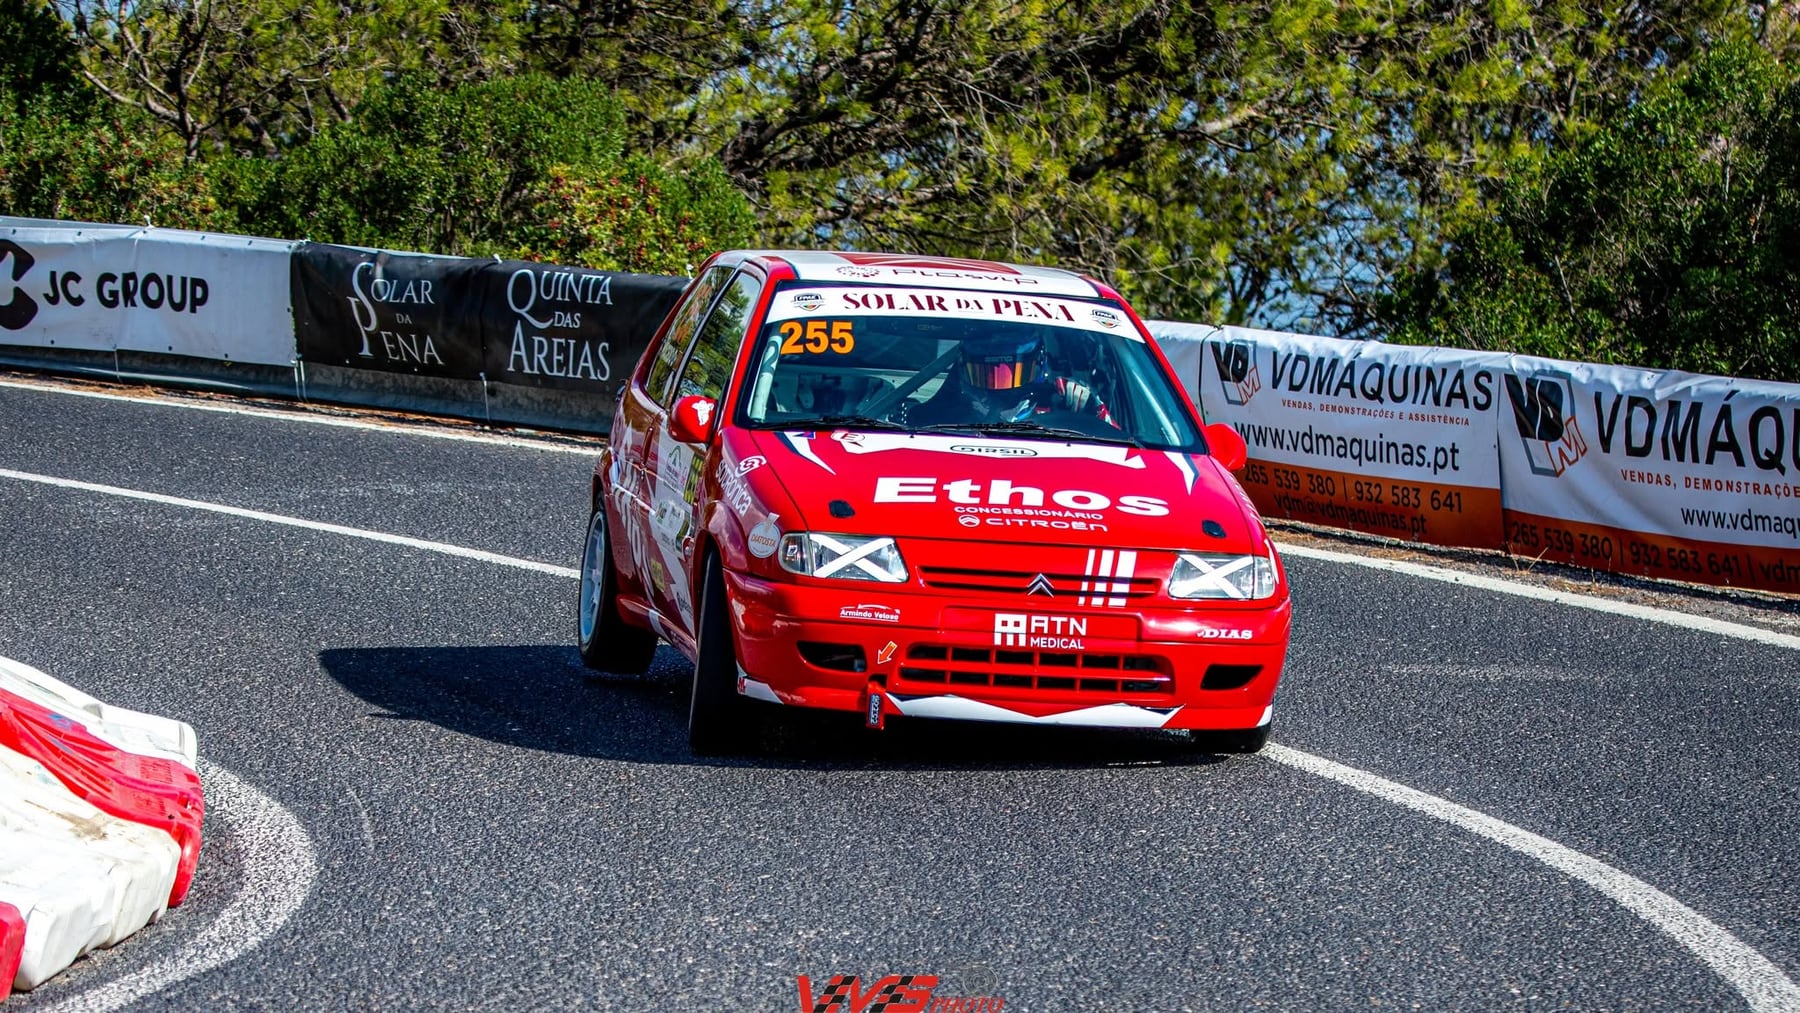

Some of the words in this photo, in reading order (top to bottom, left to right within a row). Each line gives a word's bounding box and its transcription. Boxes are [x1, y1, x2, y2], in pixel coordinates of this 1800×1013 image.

[42, 270, 85, 307] JC
[96, 271, 209, 314] GROUP
[507, 268, 613, 329] QUINTA
[843, 293, 949, 312] SOLAR
[956, 298, 984, 311] DA
[992, 298, 1076, 322] PENA
[347, 297, 445, 366] PENA
[396, 313, 412, 325] DA
[554, 311, 581, 329] DAS
[508, 320, 611, 382] AREIAS
[780, 320, 855, 355] 255
[1271, 351, 1493, 412] VDMÁQUINAS
[1282, 398, 1316, 412] VENDAS,
[1319, 403, 1395, 419] DEMONSTRAÇÕES
[1399, 411, 1404, 420] E
[1408, 411, 1470, 426] ASSISTÊNCIA
[1234, 421, 1460, 475] www.vdmaquinas.pt
[1245, 463, 1269, 485] 265
[1274, 469, 1301, 491] 539
[1306, 473, 1336, 497] 380
[1354, 480, 1383, 504] 932
[1391, 484, 1421, 509] 583
[1431, 489, 1463, 513] 641
[1621, 468, 1678, 489] VENDAS,
[873, 476, 1170, 517] Ethos
[954, 506, 1104, 520] CONCESSIONÁRIO
[1512, 521, 1539, 547] 265
[1544, 528, 1574, 554] 539
[1579, 533, 1613, 560] 380
[1630, 542, 1662, 568] 932
[1667, 547, 1702, 573] 583
[1707, 552, 1742, 577] 641
[840, 609, 872, 618] Armindo
[1030, 615, 1087, 636] ATN
[1030, 636, 1085, 650] MEDICAL
[1203, 628, 1253, 640] DIAS
